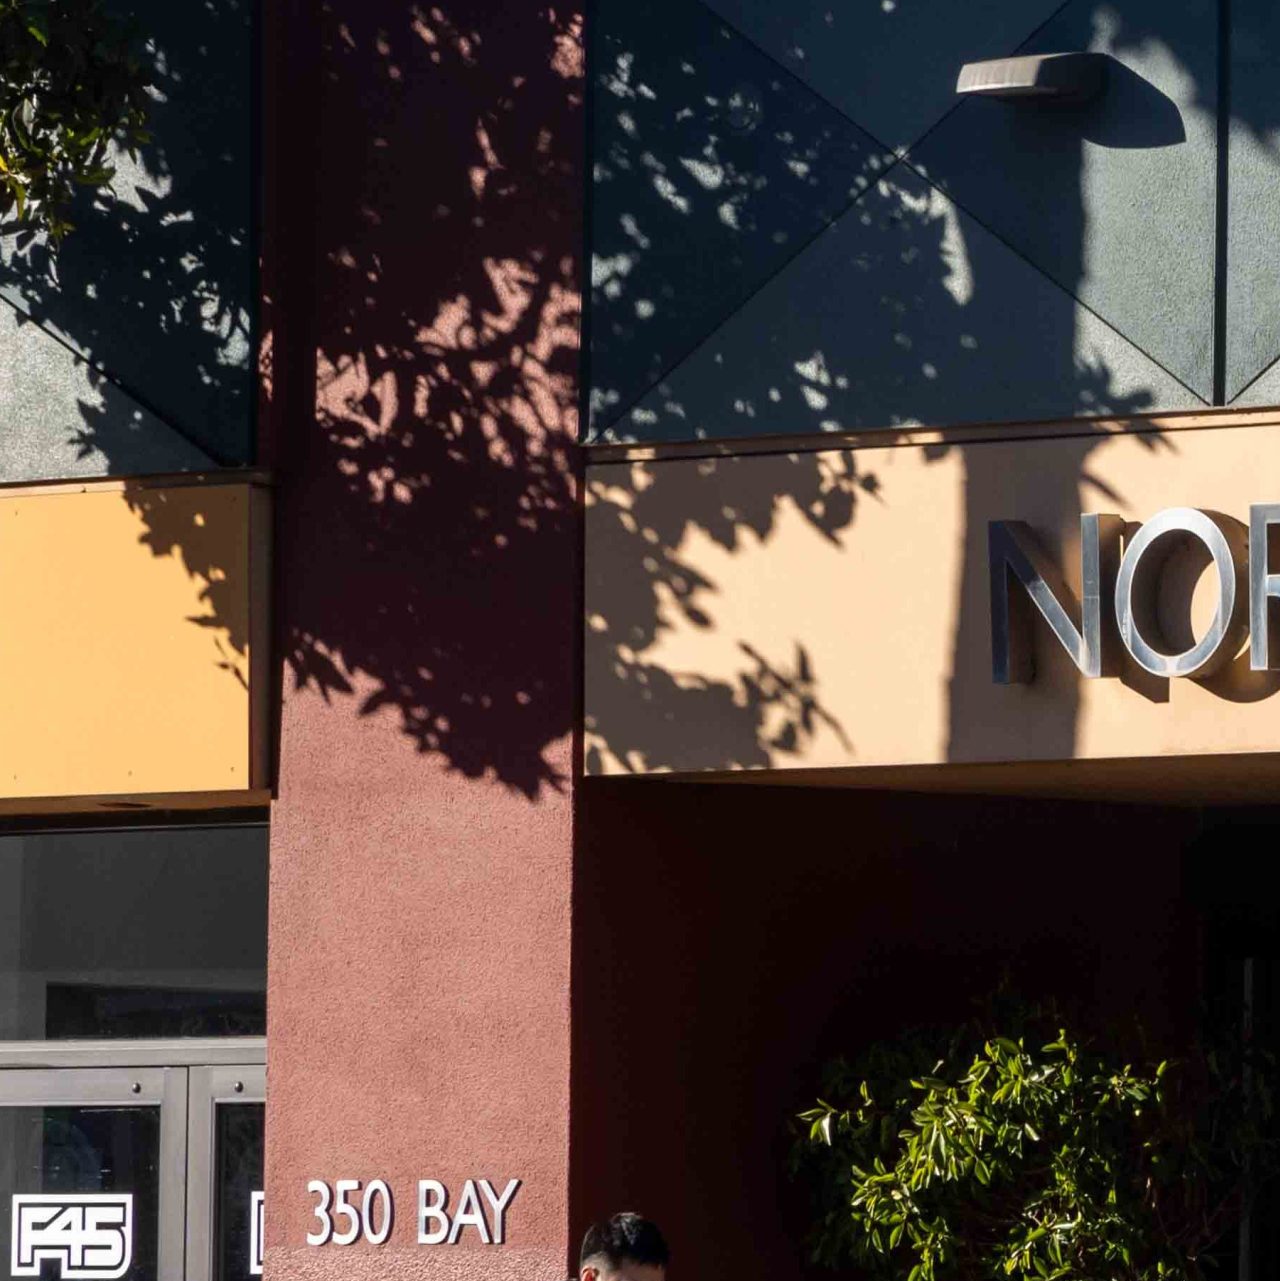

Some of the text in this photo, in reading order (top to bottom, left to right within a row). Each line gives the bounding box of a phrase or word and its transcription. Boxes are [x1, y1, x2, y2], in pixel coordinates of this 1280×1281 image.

[11, 1194, 133, 1279] F45
[306, 1179, 391, 1246] 350
[417, 1178, 520, 1245] BAY
